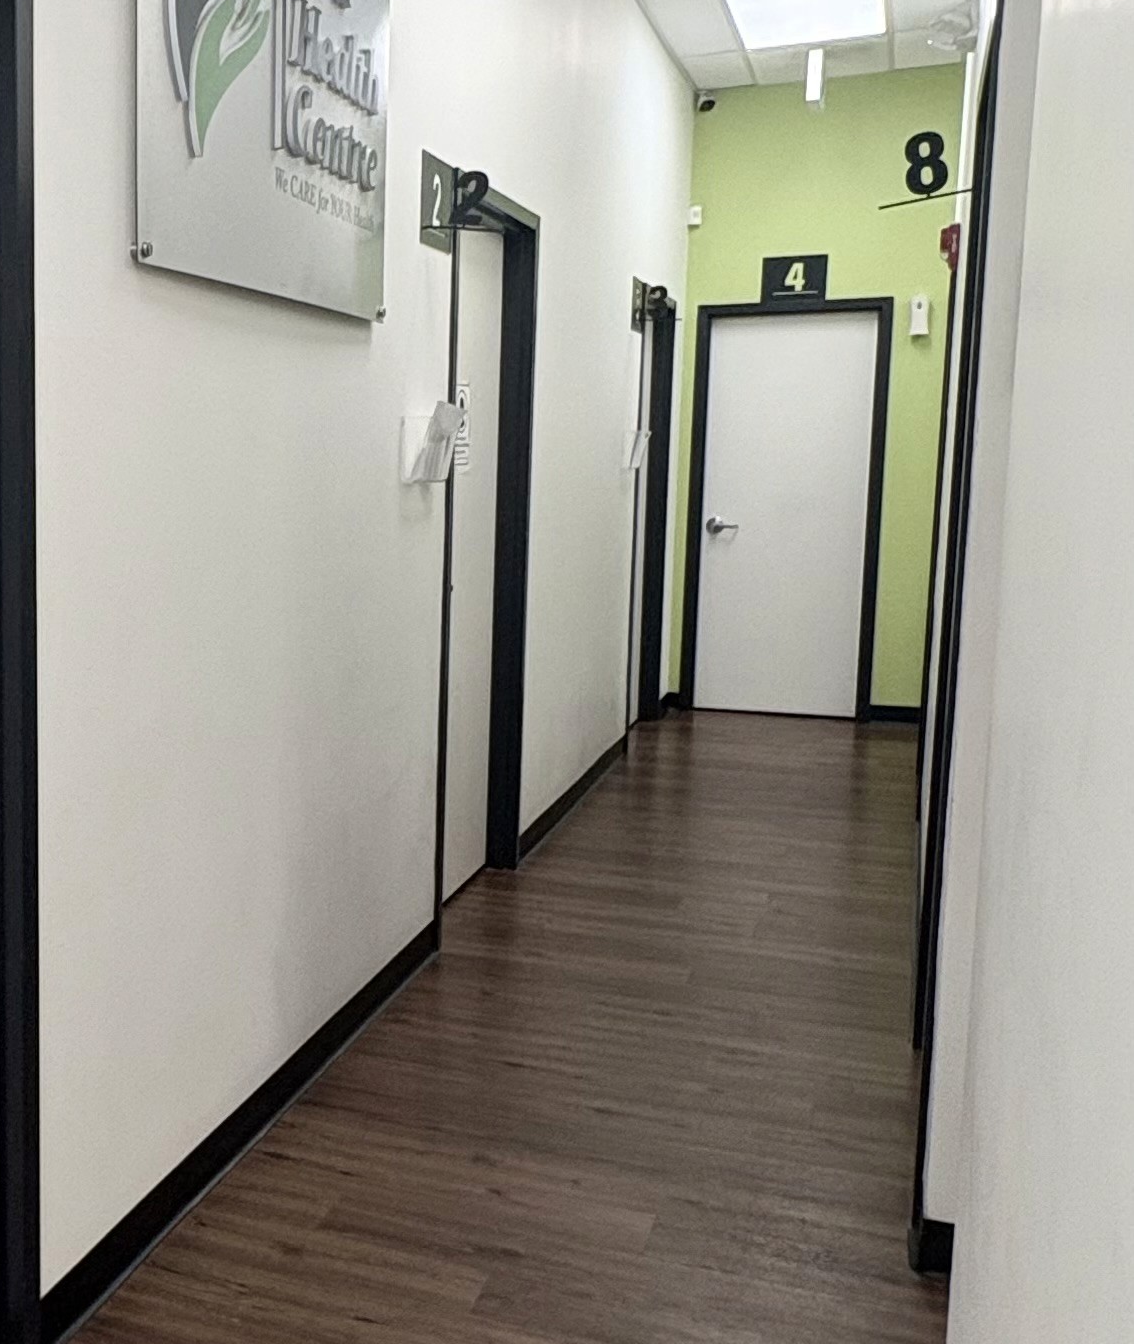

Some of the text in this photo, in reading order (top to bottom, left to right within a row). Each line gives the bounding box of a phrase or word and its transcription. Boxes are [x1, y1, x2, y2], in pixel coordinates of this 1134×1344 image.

[286, 85, 378, 192] Centre
[905, 131, 948, 195] 8
[275, 166, 289, 193] We
[290, 175, 317, 207] CARE
[448, 170, 489, 225] 2
[784, 262, 806, 292] 4
